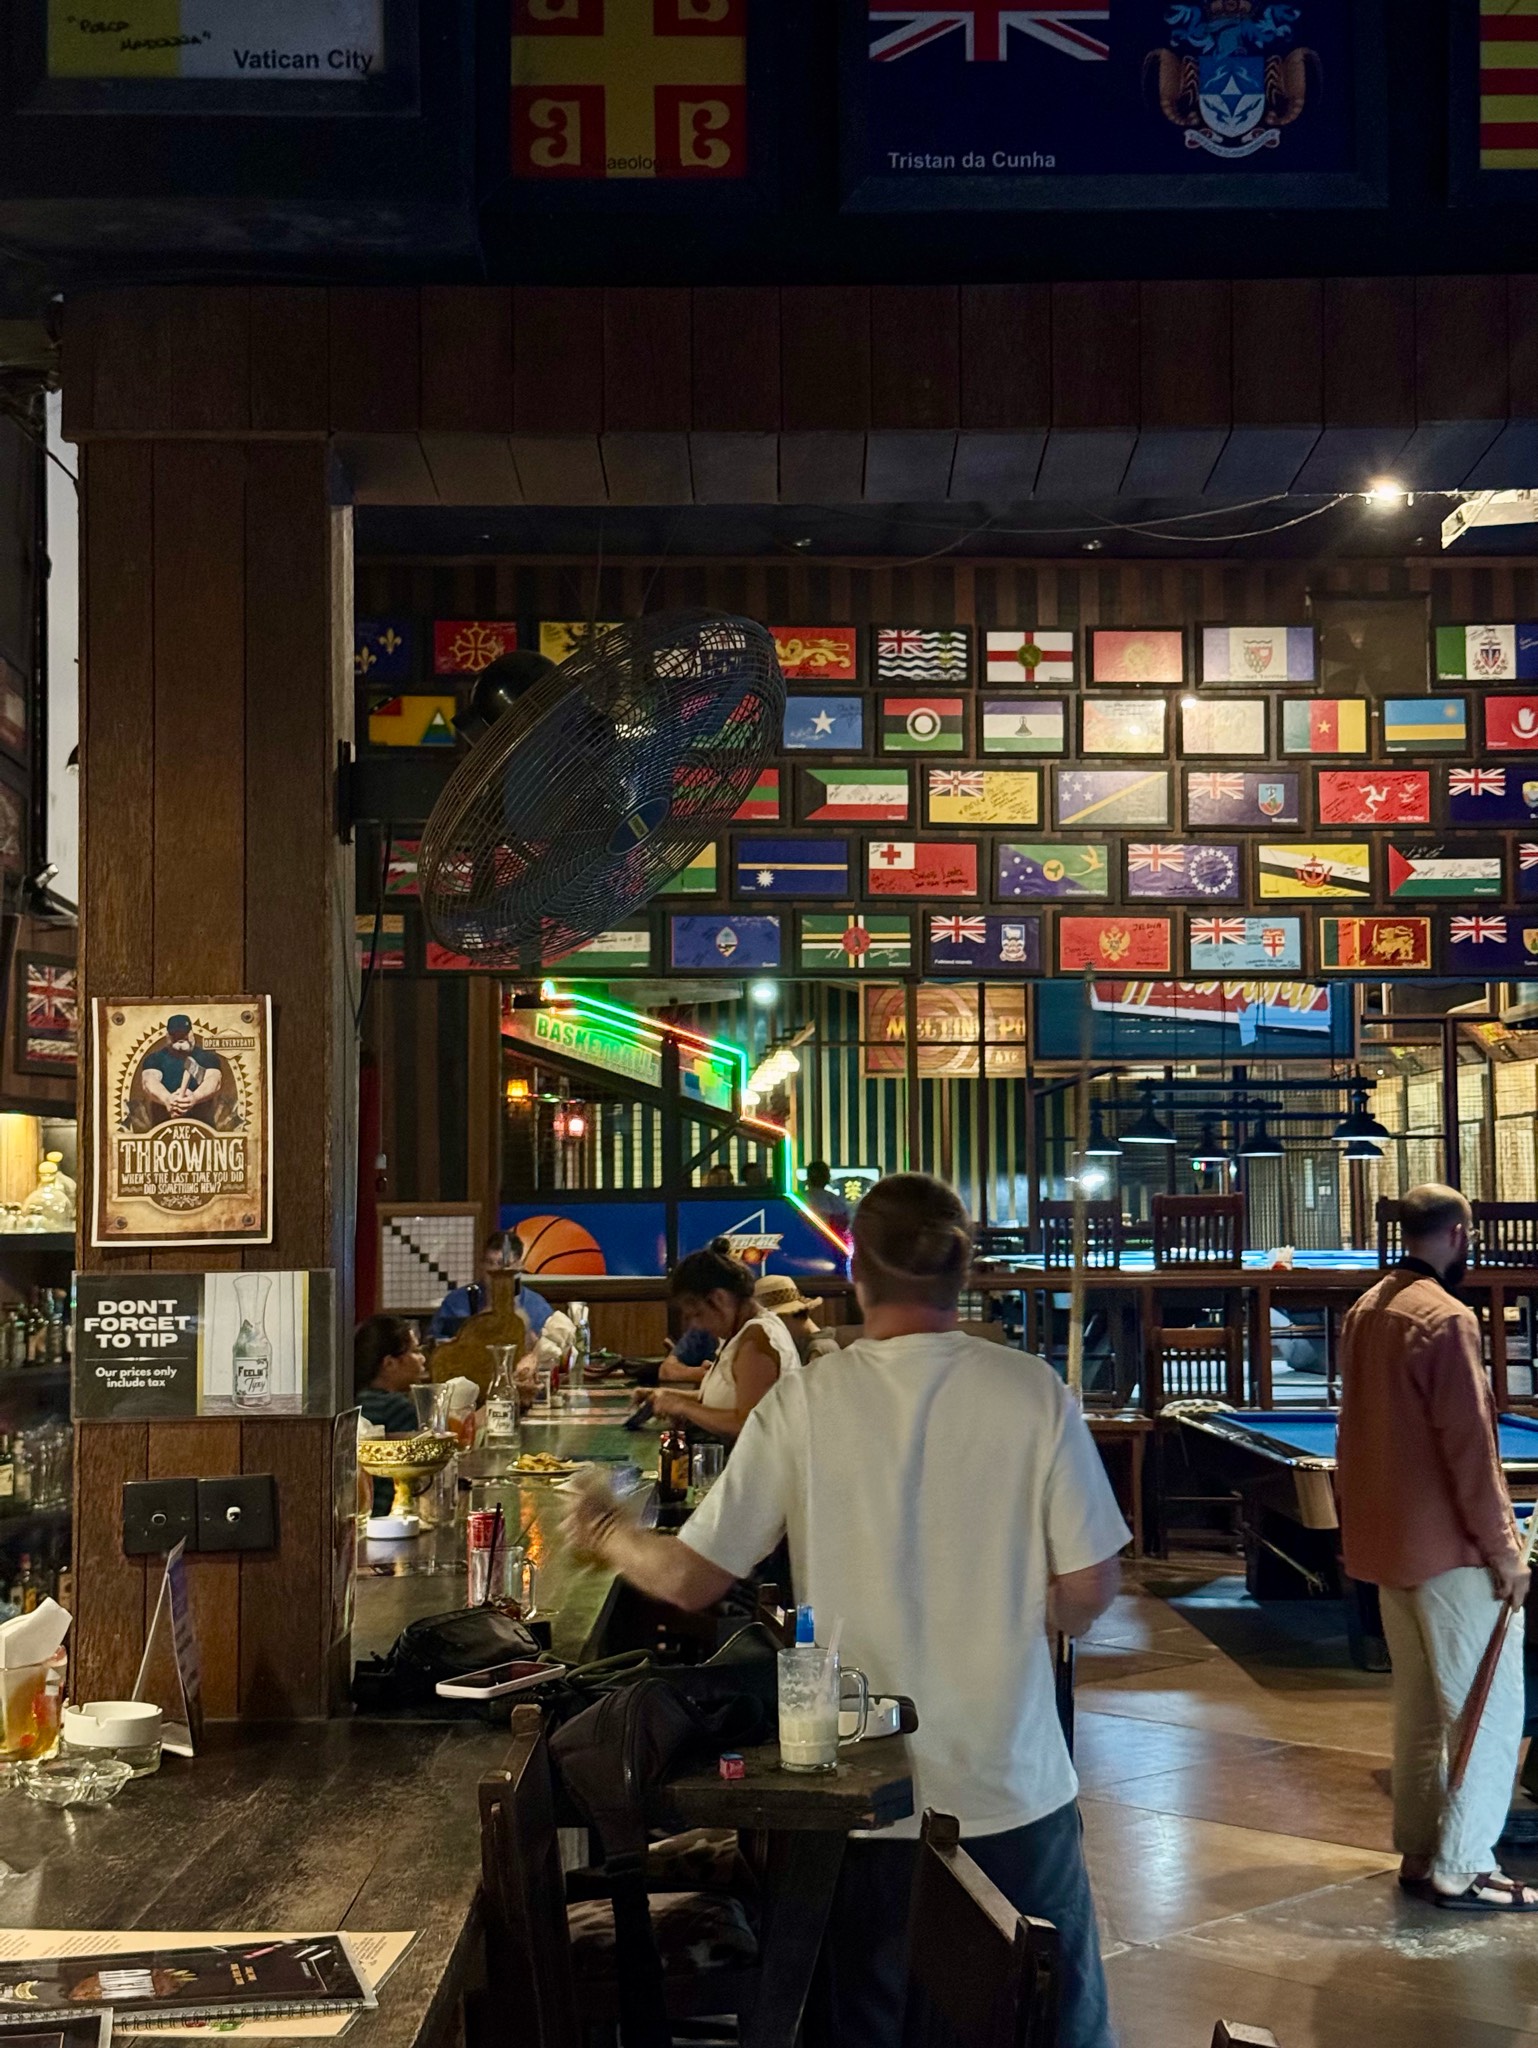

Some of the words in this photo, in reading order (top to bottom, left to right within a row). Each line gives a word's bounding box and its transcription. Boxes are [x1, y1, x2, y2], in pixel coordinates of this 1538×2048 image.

[234, 49, 320, 70] Vatican
[327, 49, 374, 74] City
[887, 151, 956, 170] Tristan
[961, 150, 987, 169] da
[991, 150, 1057, 169] Cunha
[203, 1038, 220, 1048] OPEN
[172, 1125, 191, 1140] AXE
[119, 1138, 245, 1173] THROWING
[121, 1173, 151, 1184] WHEN'S
[154, 1173, 169, 1184] THE
[171, 1173, 190, 1183] LAST
[192, 1172, 210, 1183] TIME
[213, 1172, 229, 1182] YOU
[231, 1171, 244, 1182] DID
[143, 1183, 157, 1195] DID
[157, 1182, 199, 1194] SOMETHING
[200, 1182, 223, 1194] NEW?
[83, 1315, 191, 1332] FORGET
[95, 1333, 132, 1349] TO
[134, 1332, 179, 1348] TIP
[95, 1366, 118, 1378] Our
[119, 1366, 152, 1379] prices
[153, 1365, 178, 1379] only
[106, 1377, 146, 1388] include
[147, 1377, 166, 1388] tax
